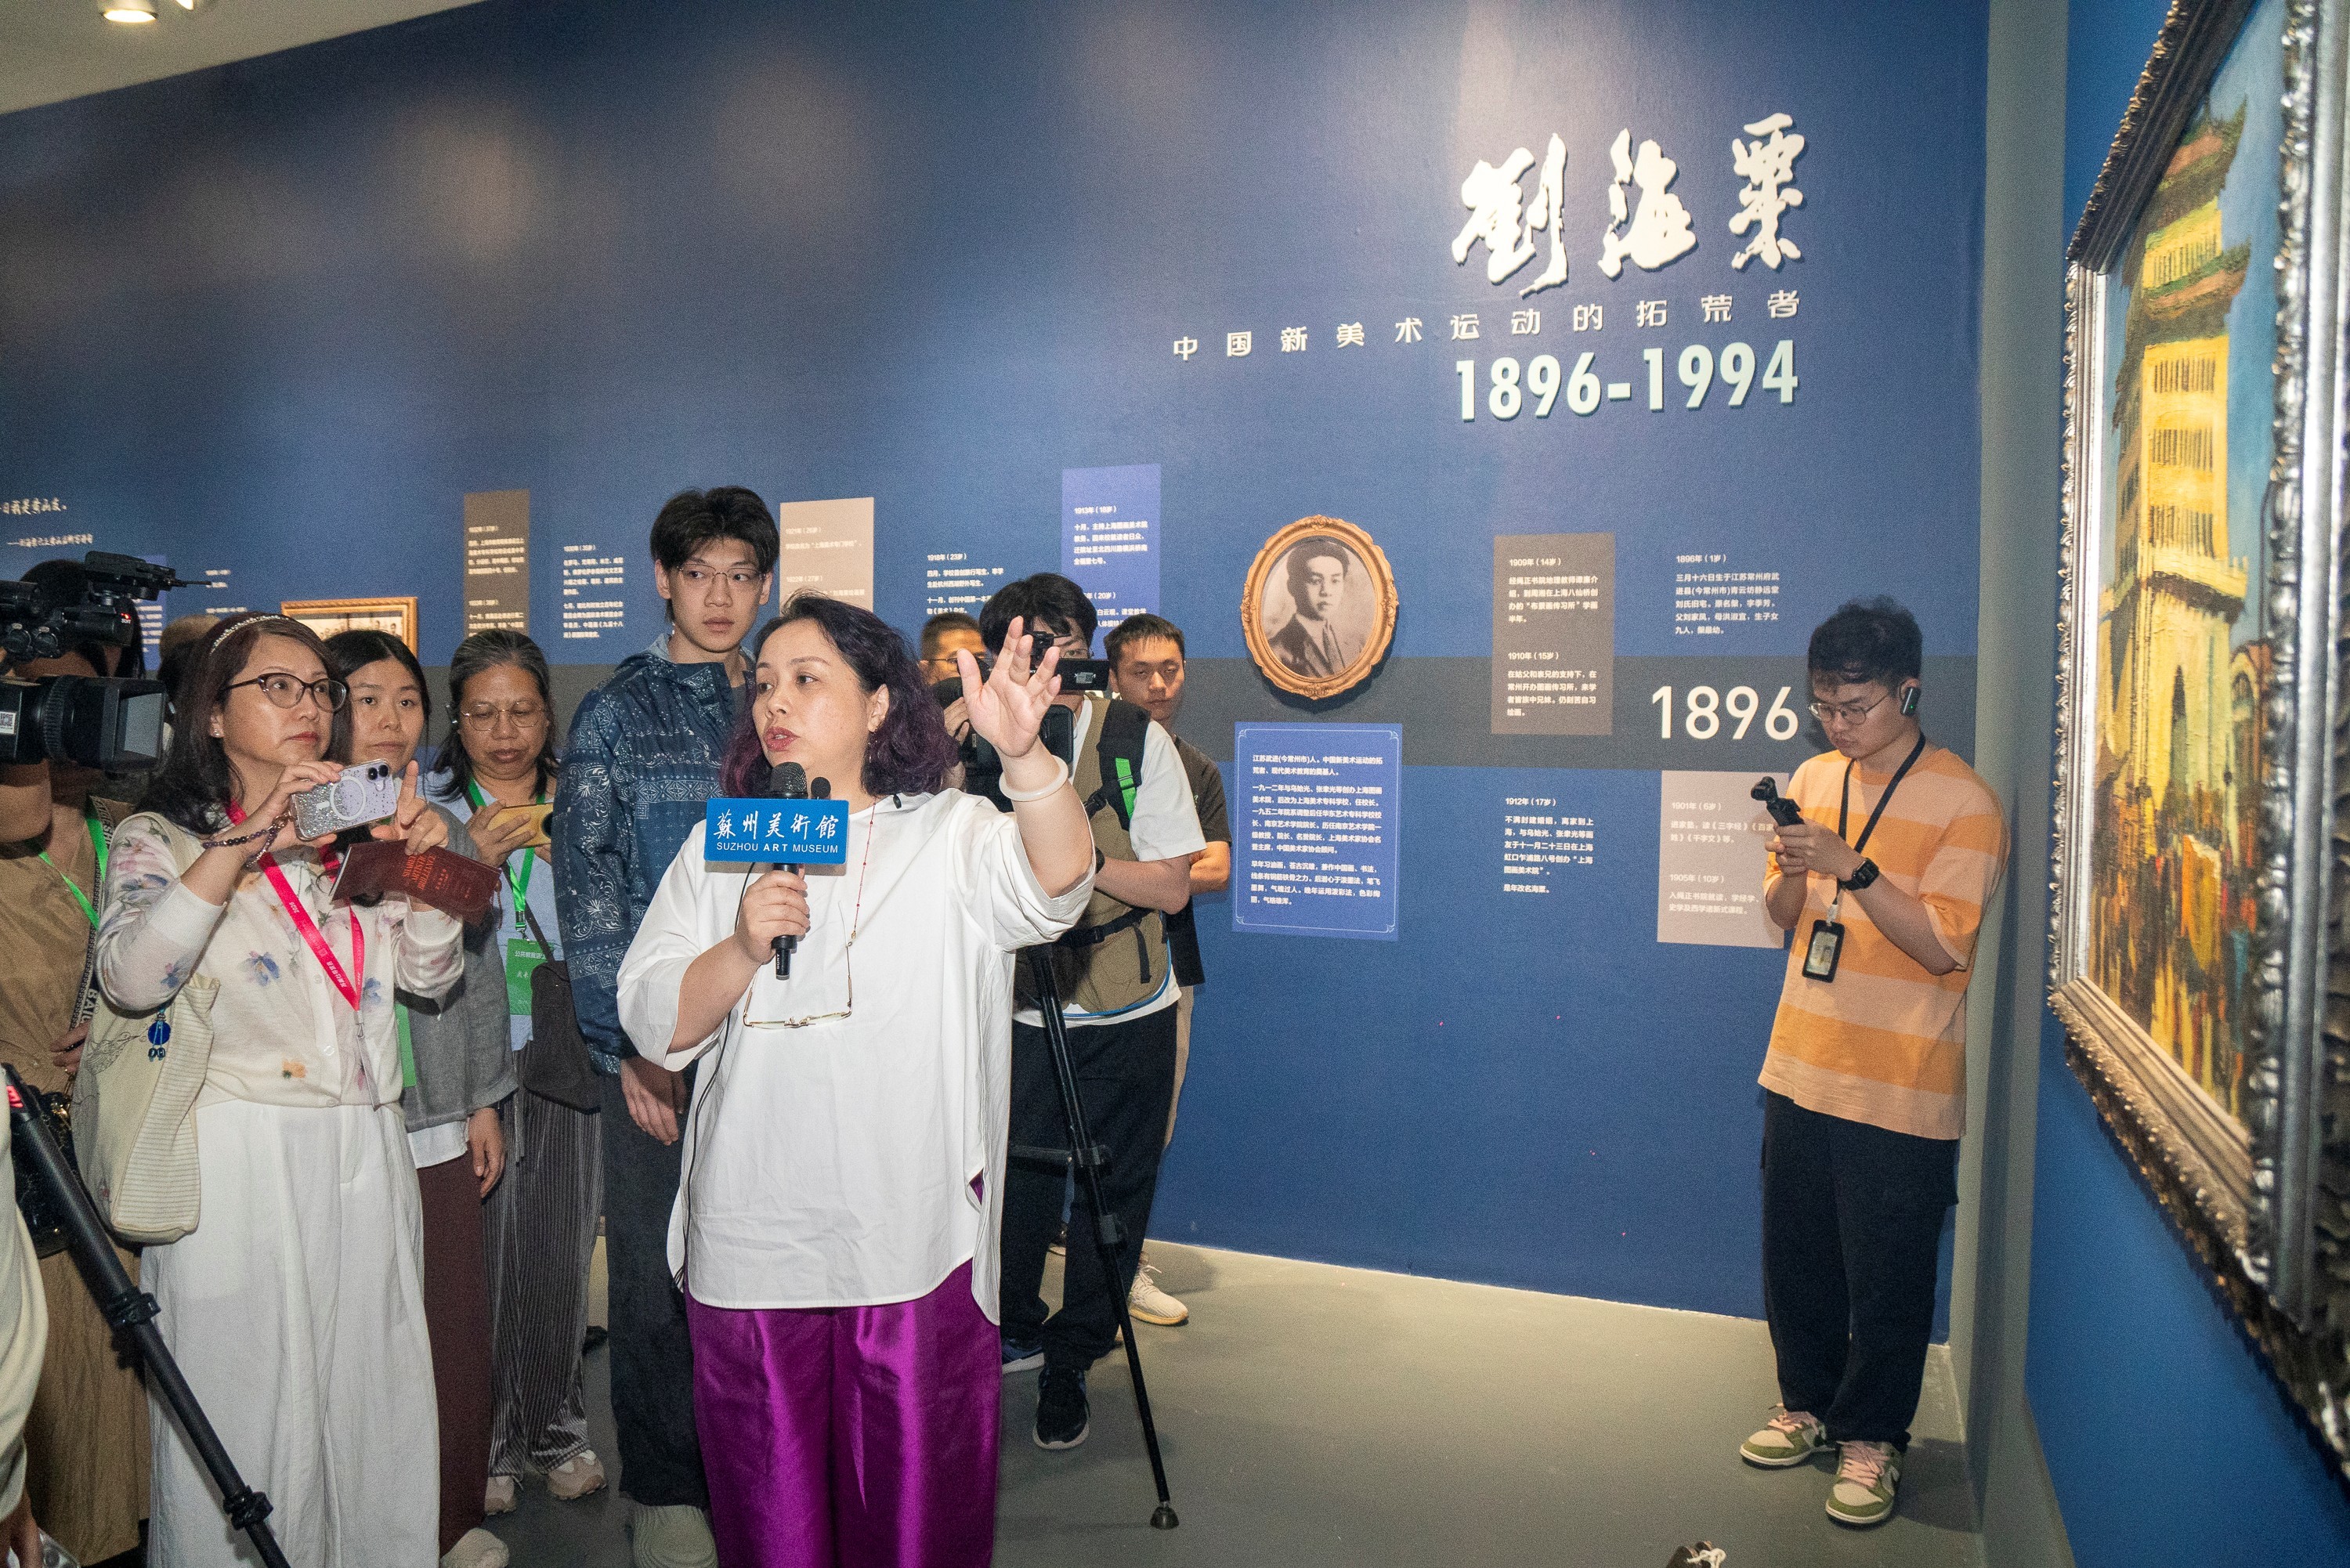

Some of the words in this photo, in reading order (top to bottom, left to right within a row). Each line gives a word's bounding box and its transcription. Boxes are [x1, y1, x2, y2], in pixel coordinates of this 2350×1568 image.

[1173, 290, 1799, 360] 中国新美术运动的拓荒者
[1455, 341, 1797, 419] 1896-1994
[1676, 555, 1726, 563] 1896年（1岁）
[1652, 686, 1797, 740] 1896
[1671, 802, 1722, 811] 1901年（6岁）
[714, 809, 839, 840] 蘇州美術館
[717, 842, 758, 851] SUZHOU
[793, 844, 838, 853] MUSEUM
[1669, 874, 1724, 883] 1905年（10岁）
